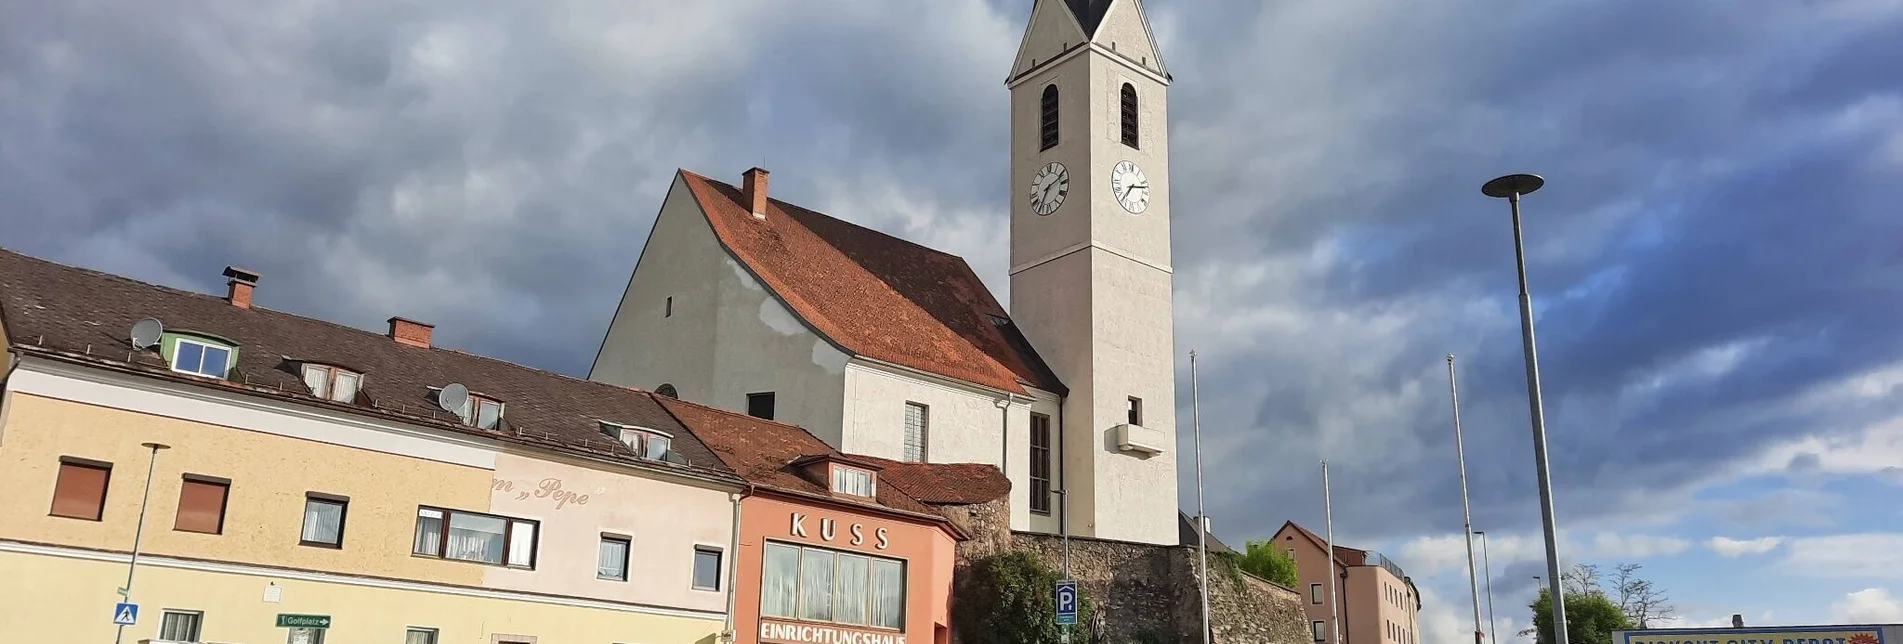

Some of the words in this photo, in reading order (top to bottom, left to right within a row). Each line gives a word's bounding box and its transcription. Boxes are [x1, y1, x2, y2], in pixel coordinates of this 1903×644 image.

[790, 512, 889, 550] KUSS
[1059, 591, 1073, 611] P
[287, 616, 320, 626] Golfplatz
